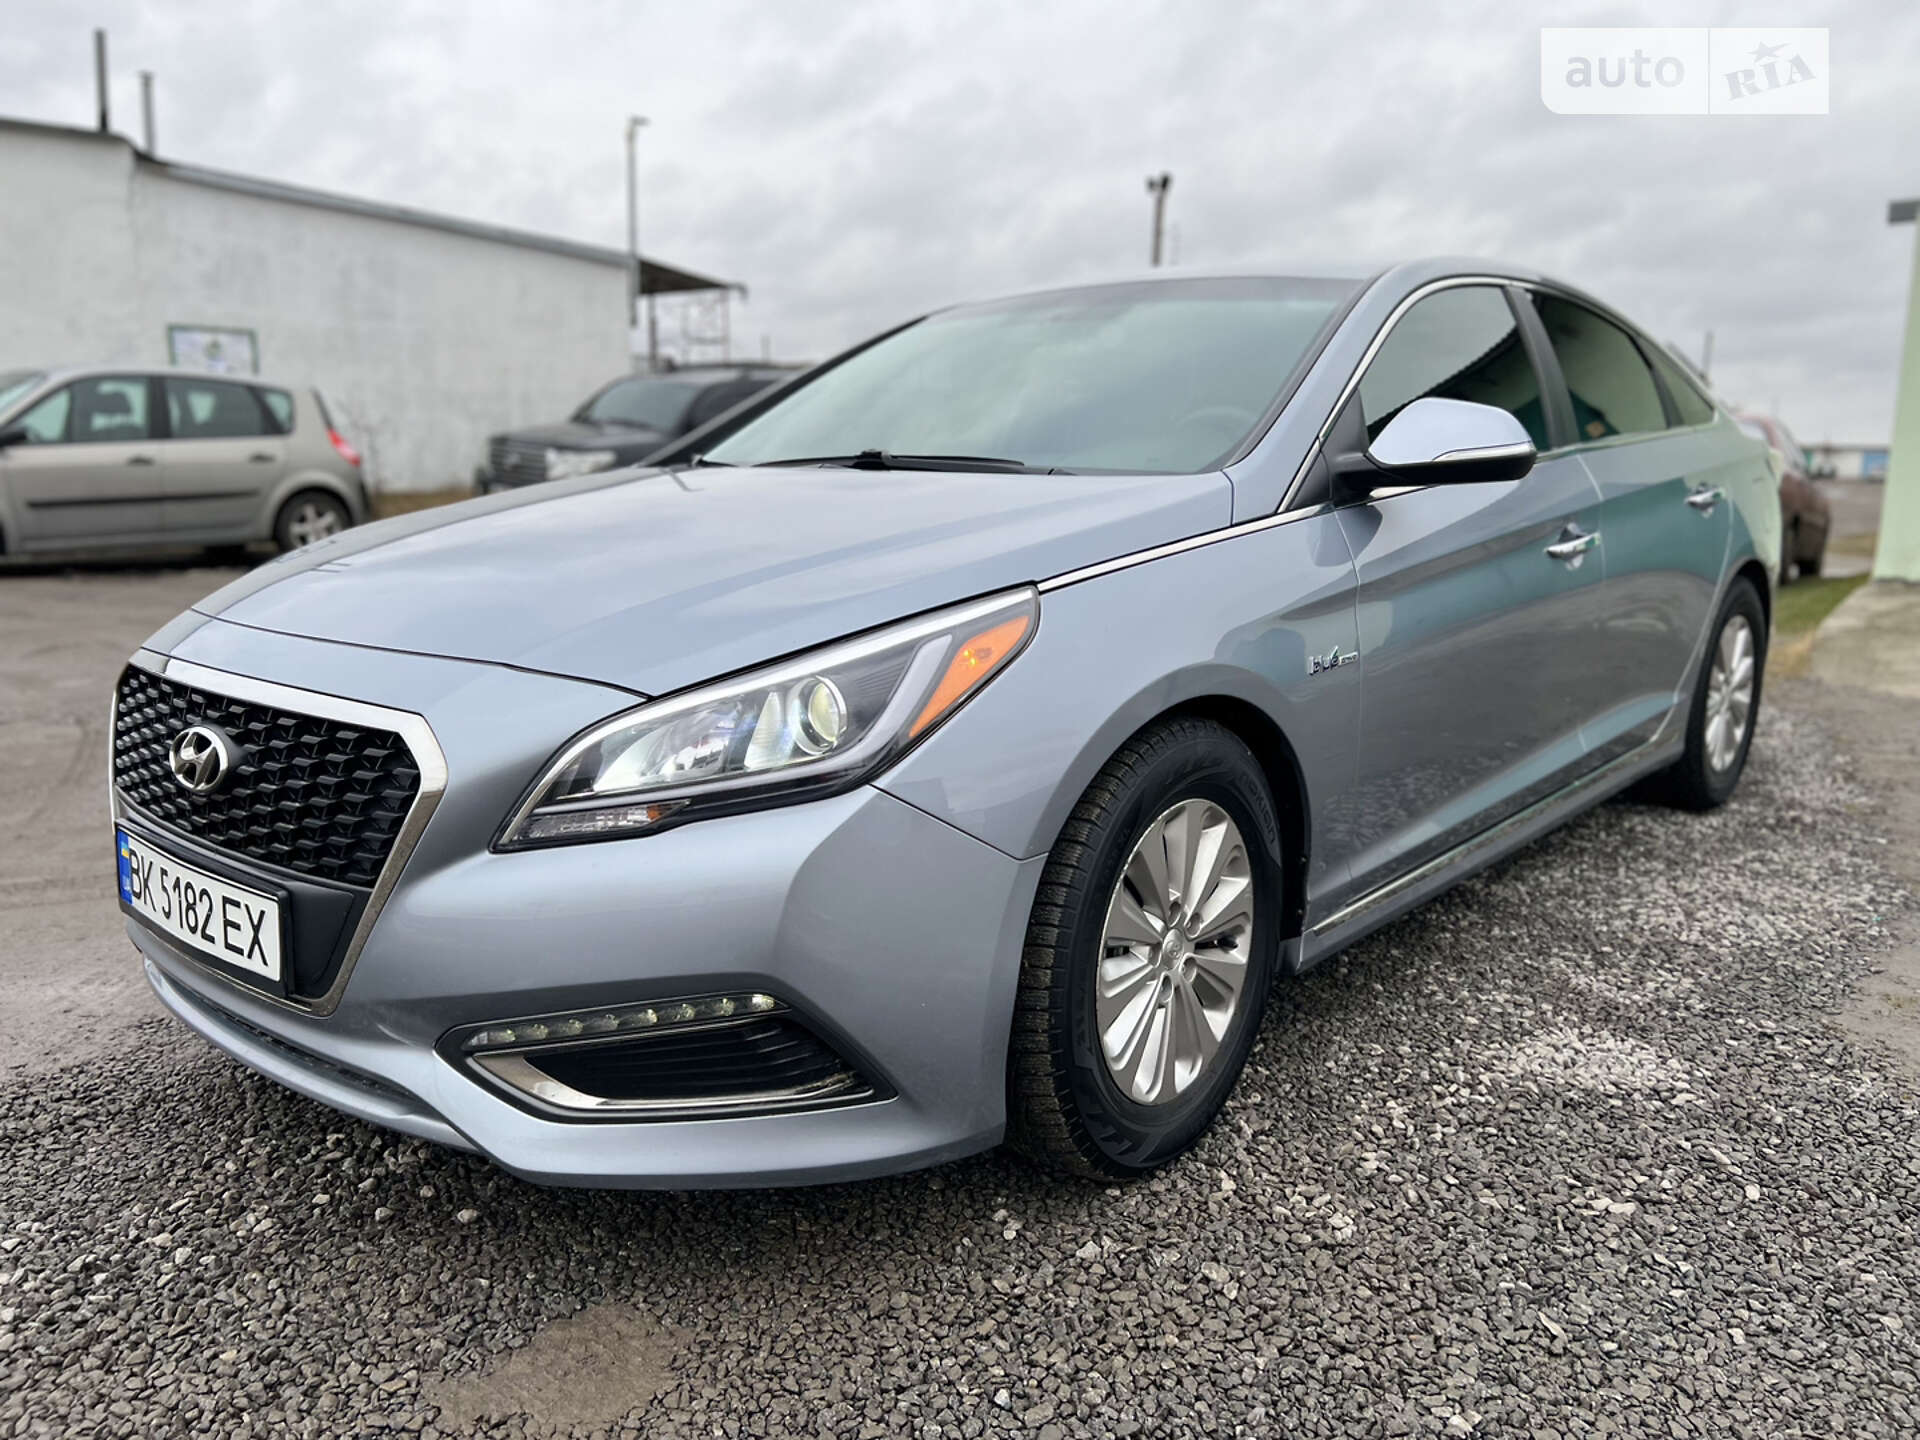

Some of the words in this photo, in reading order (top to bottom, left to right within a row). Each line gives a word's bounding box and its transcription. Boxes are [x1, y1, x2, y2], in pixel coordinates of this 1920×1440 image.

[129, 848, 156, 912] BK
[160, 866, 215, 944] 5182
[222, 895, 269, 966] EX
